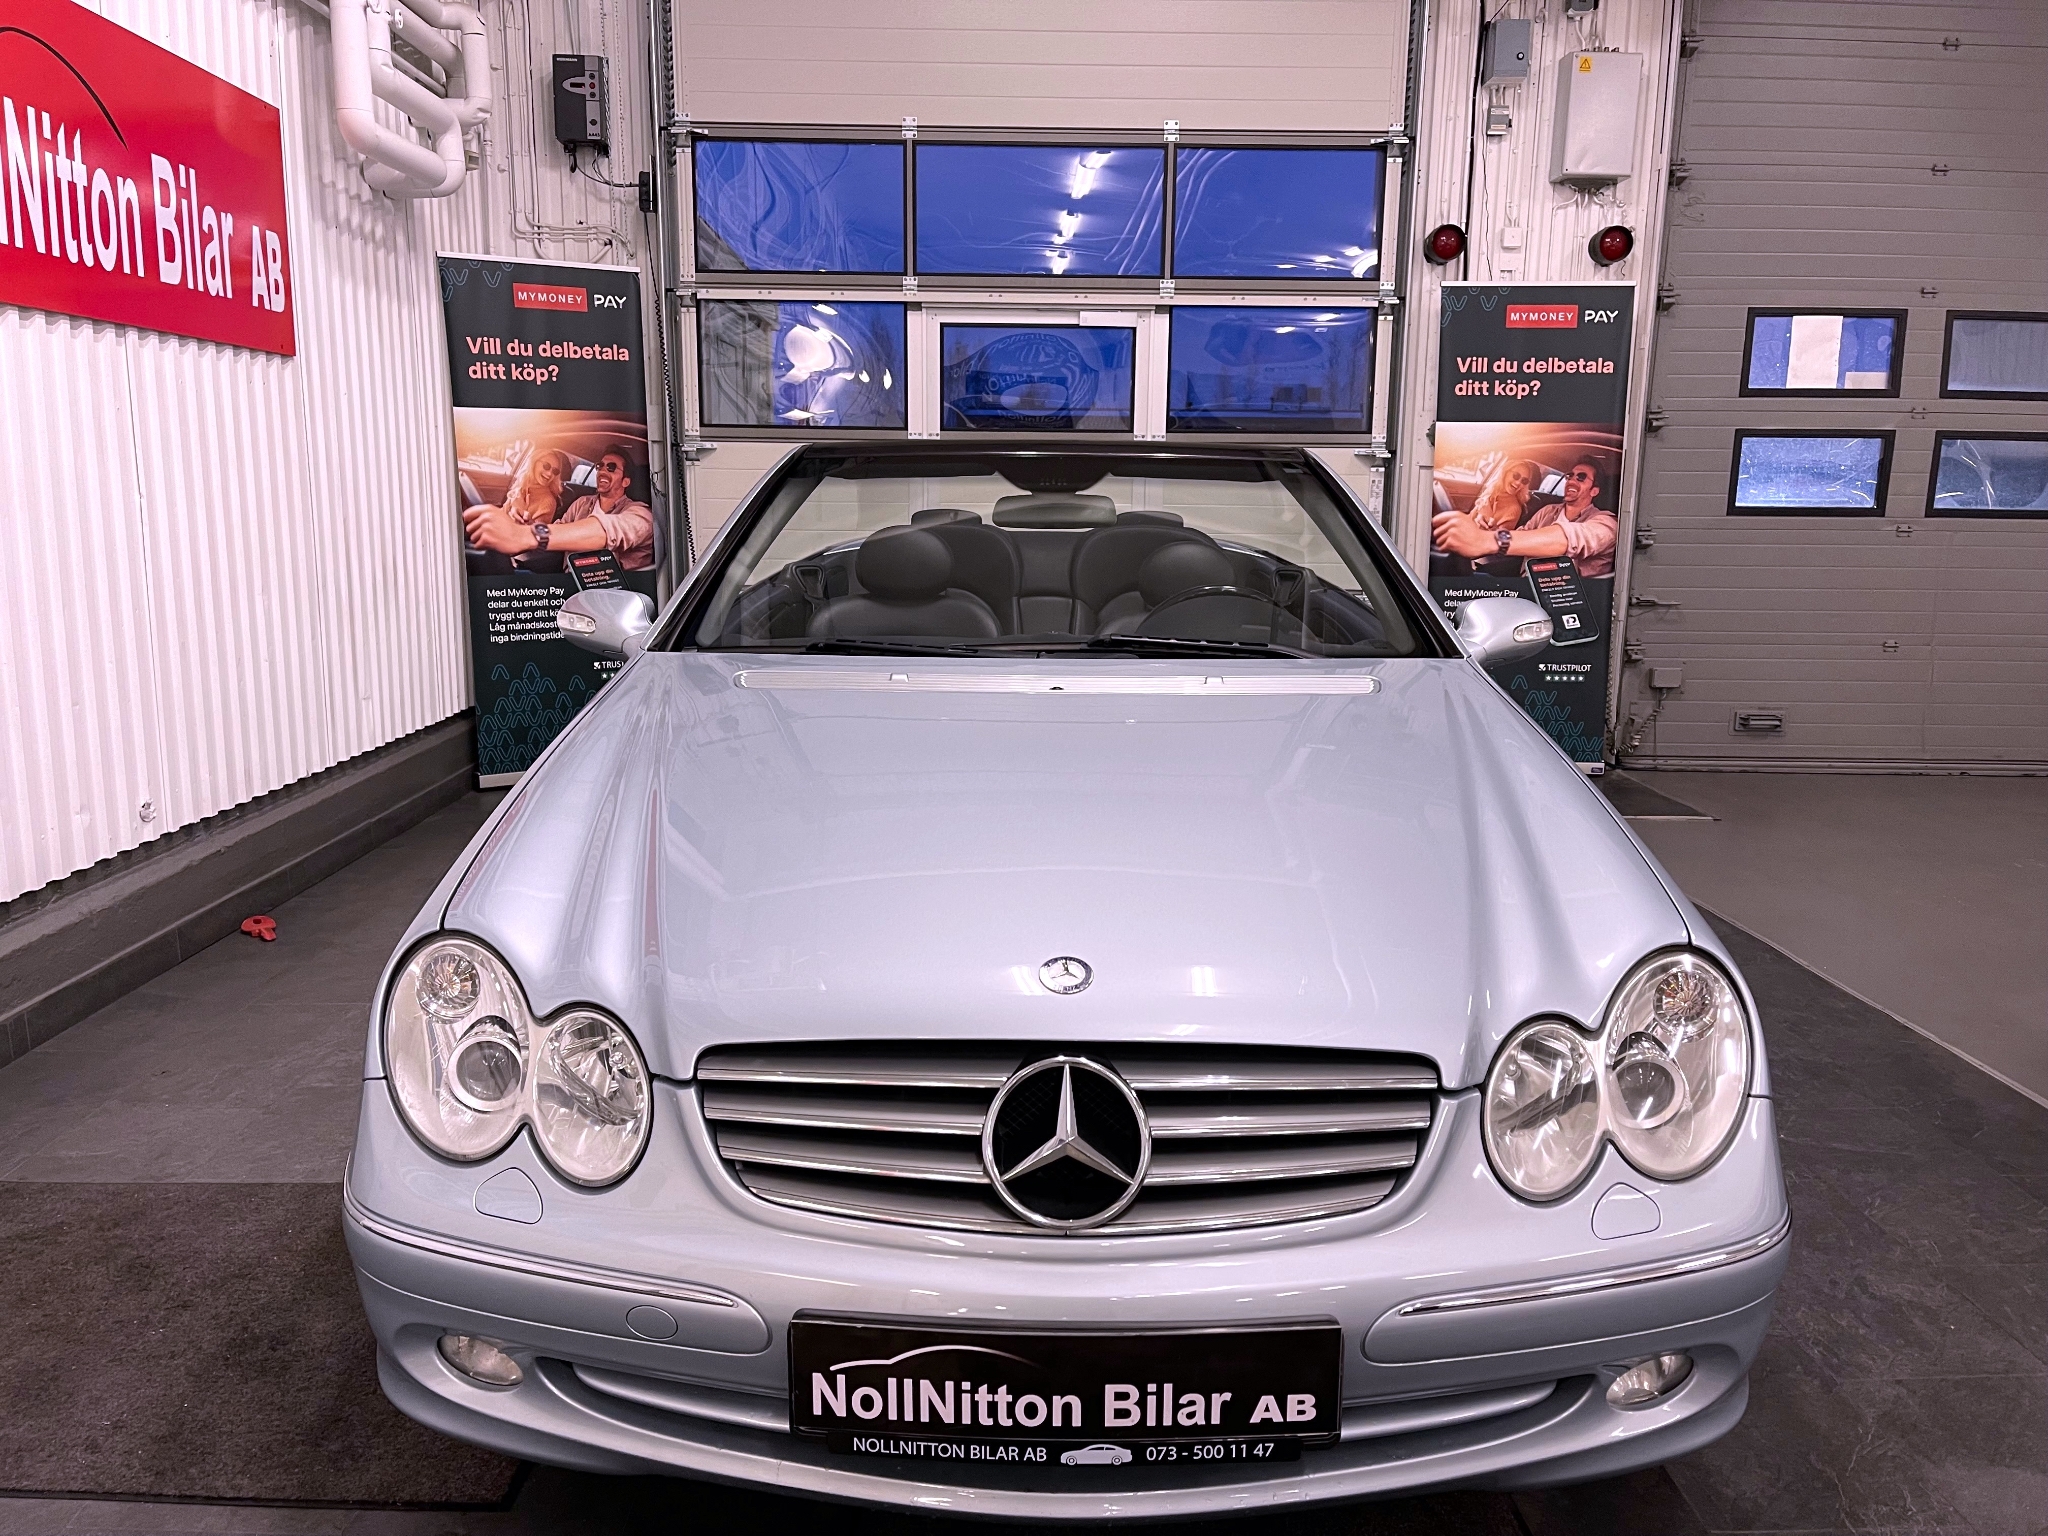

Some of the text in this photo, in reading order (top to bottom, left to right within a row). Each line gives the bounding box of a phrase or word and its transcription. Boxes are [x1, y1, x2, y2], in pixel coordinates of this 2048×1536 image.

[150, 152, 233, 299] Bilar
[252, 225, 285, 313] AB
[518, 292, 626, 308] MYMONEY PAY
[1510, 310, 1618, 323] MYMONEY PAY
[466, 336, 630, 361] Vill du delbetala
[1456, 356, 1614, 374] Vill du delbetala
[468, 362, 560, 385] ditt köp?
[1454, 380, 1541, 400] ditt köp?
[486, 587, 564, 597] Med MyMoney Pay
[1464, 589, 1502, 598] MyMoney
[1504, 590, 1518, 598] Pay
[488, 600, 509, 608] delar
[489, 612, 515, 622] tryggt
[517, 612, 532, 620] upp
[1444, 610, 1455, 618] try
[490, 621, 558, 632] Låg månadskost
[490, 632, 564, 644] inga bindningstide
[812, 1372, 1317, 1427] NollNitton Bilar AB
[854, 1438, 965, 1458] NOLLNITTON
[970, 1445, 1019, 1460] BILAR
[1024, 1447, 1047, 1462] AB
[1146, 1447, 1177, 1460] 073
[1193, 1445, 1224, 1459] 500
[1230, 1444, 1247, 1458] 11
[1253, 1443, 1274, 1458] 47
